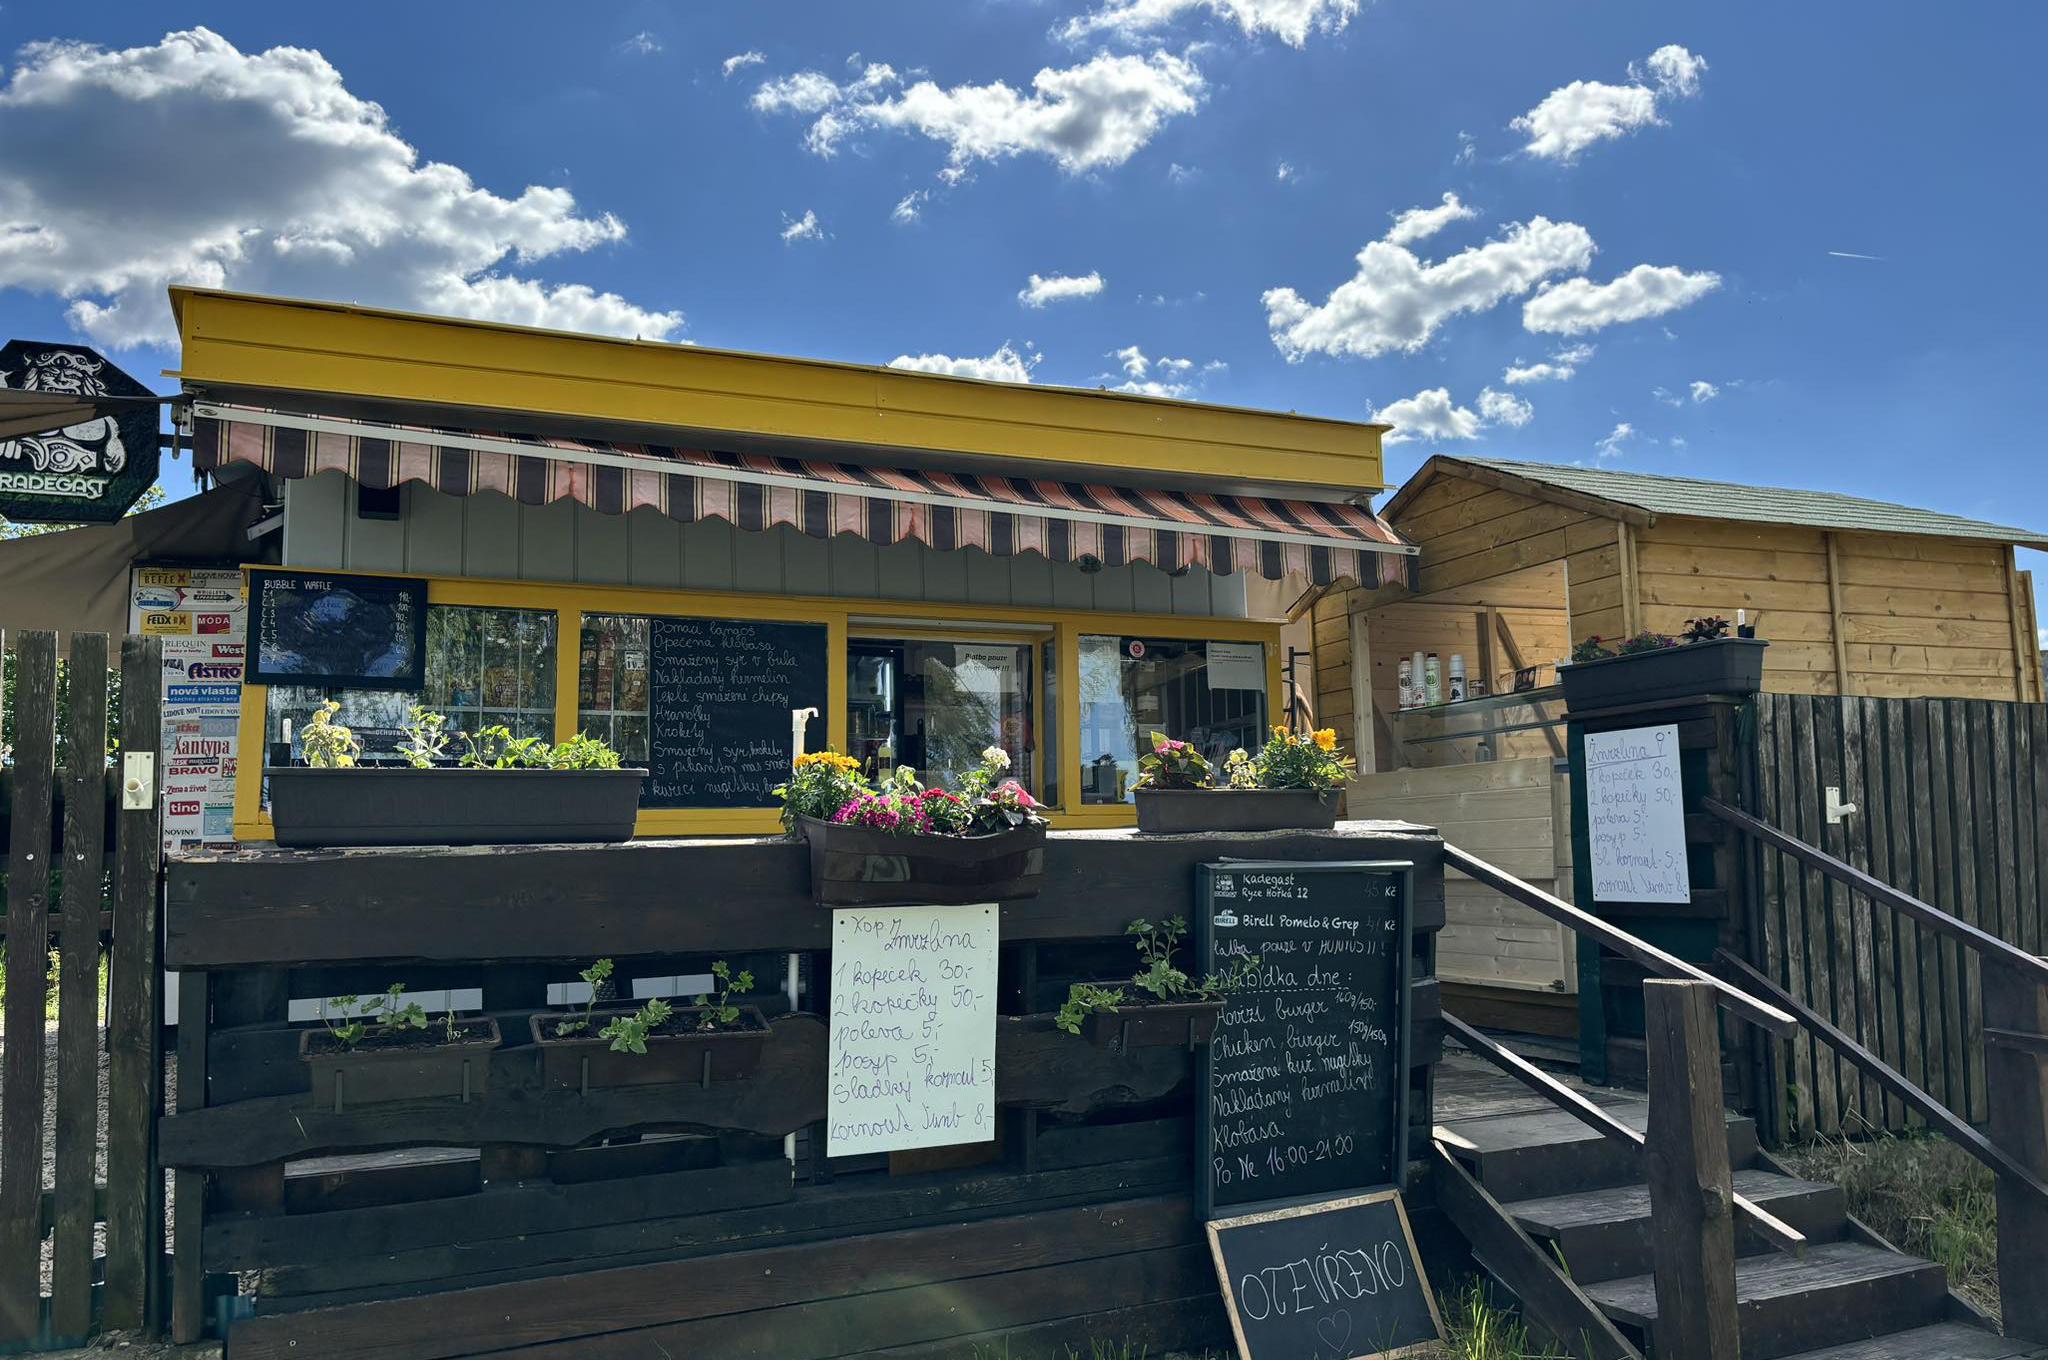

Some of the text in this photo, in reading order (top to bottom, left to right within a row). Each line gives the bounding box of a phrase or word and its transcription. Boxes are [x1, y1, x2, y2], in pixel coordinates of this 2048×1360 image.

[0, 474, 109, 499] RADEGAST
[263, 579, 296, 590] BUBBLE
[147, 614, 171, 625] FELIX
[198, 617, 230, 625] MODA
[164, 640, 207, 649] RLEQUIN
[188, 662, 241, 679] ASTRO
[170, 686, 237, 695] nová vlasta
[174, 735, 230, 757] Xantypa
[1589, 739, 1650, 763] Zmrzlina
[169, 766, 218, 775] BRAVO
[1593, 832, 1626, 851] posyp
[1266, 887, 1293, 898] Hořká
[1296, 887, 1308, 899] 12
[1384, 884, 1397, 897] Kč
[1243, 915, 1274, 927] Birell
[1384, 919, 1397, 931] Kč
[884, 918, 977, 952] Zmrzlina
[835, 958, 974, 992] 1 kopeček 30,-
[834, 985, 985, 1018] 2 kopečky 50,-
[1275, 998, 1329, 1024] burger
[834, 1020, 914, 1050] poleva
[1214, 1030, 1276, 1061] Chicken
[835, 1051, 898, 1077] posyp
[1242, 1242, 1404, 1320] OTEVŘENO
